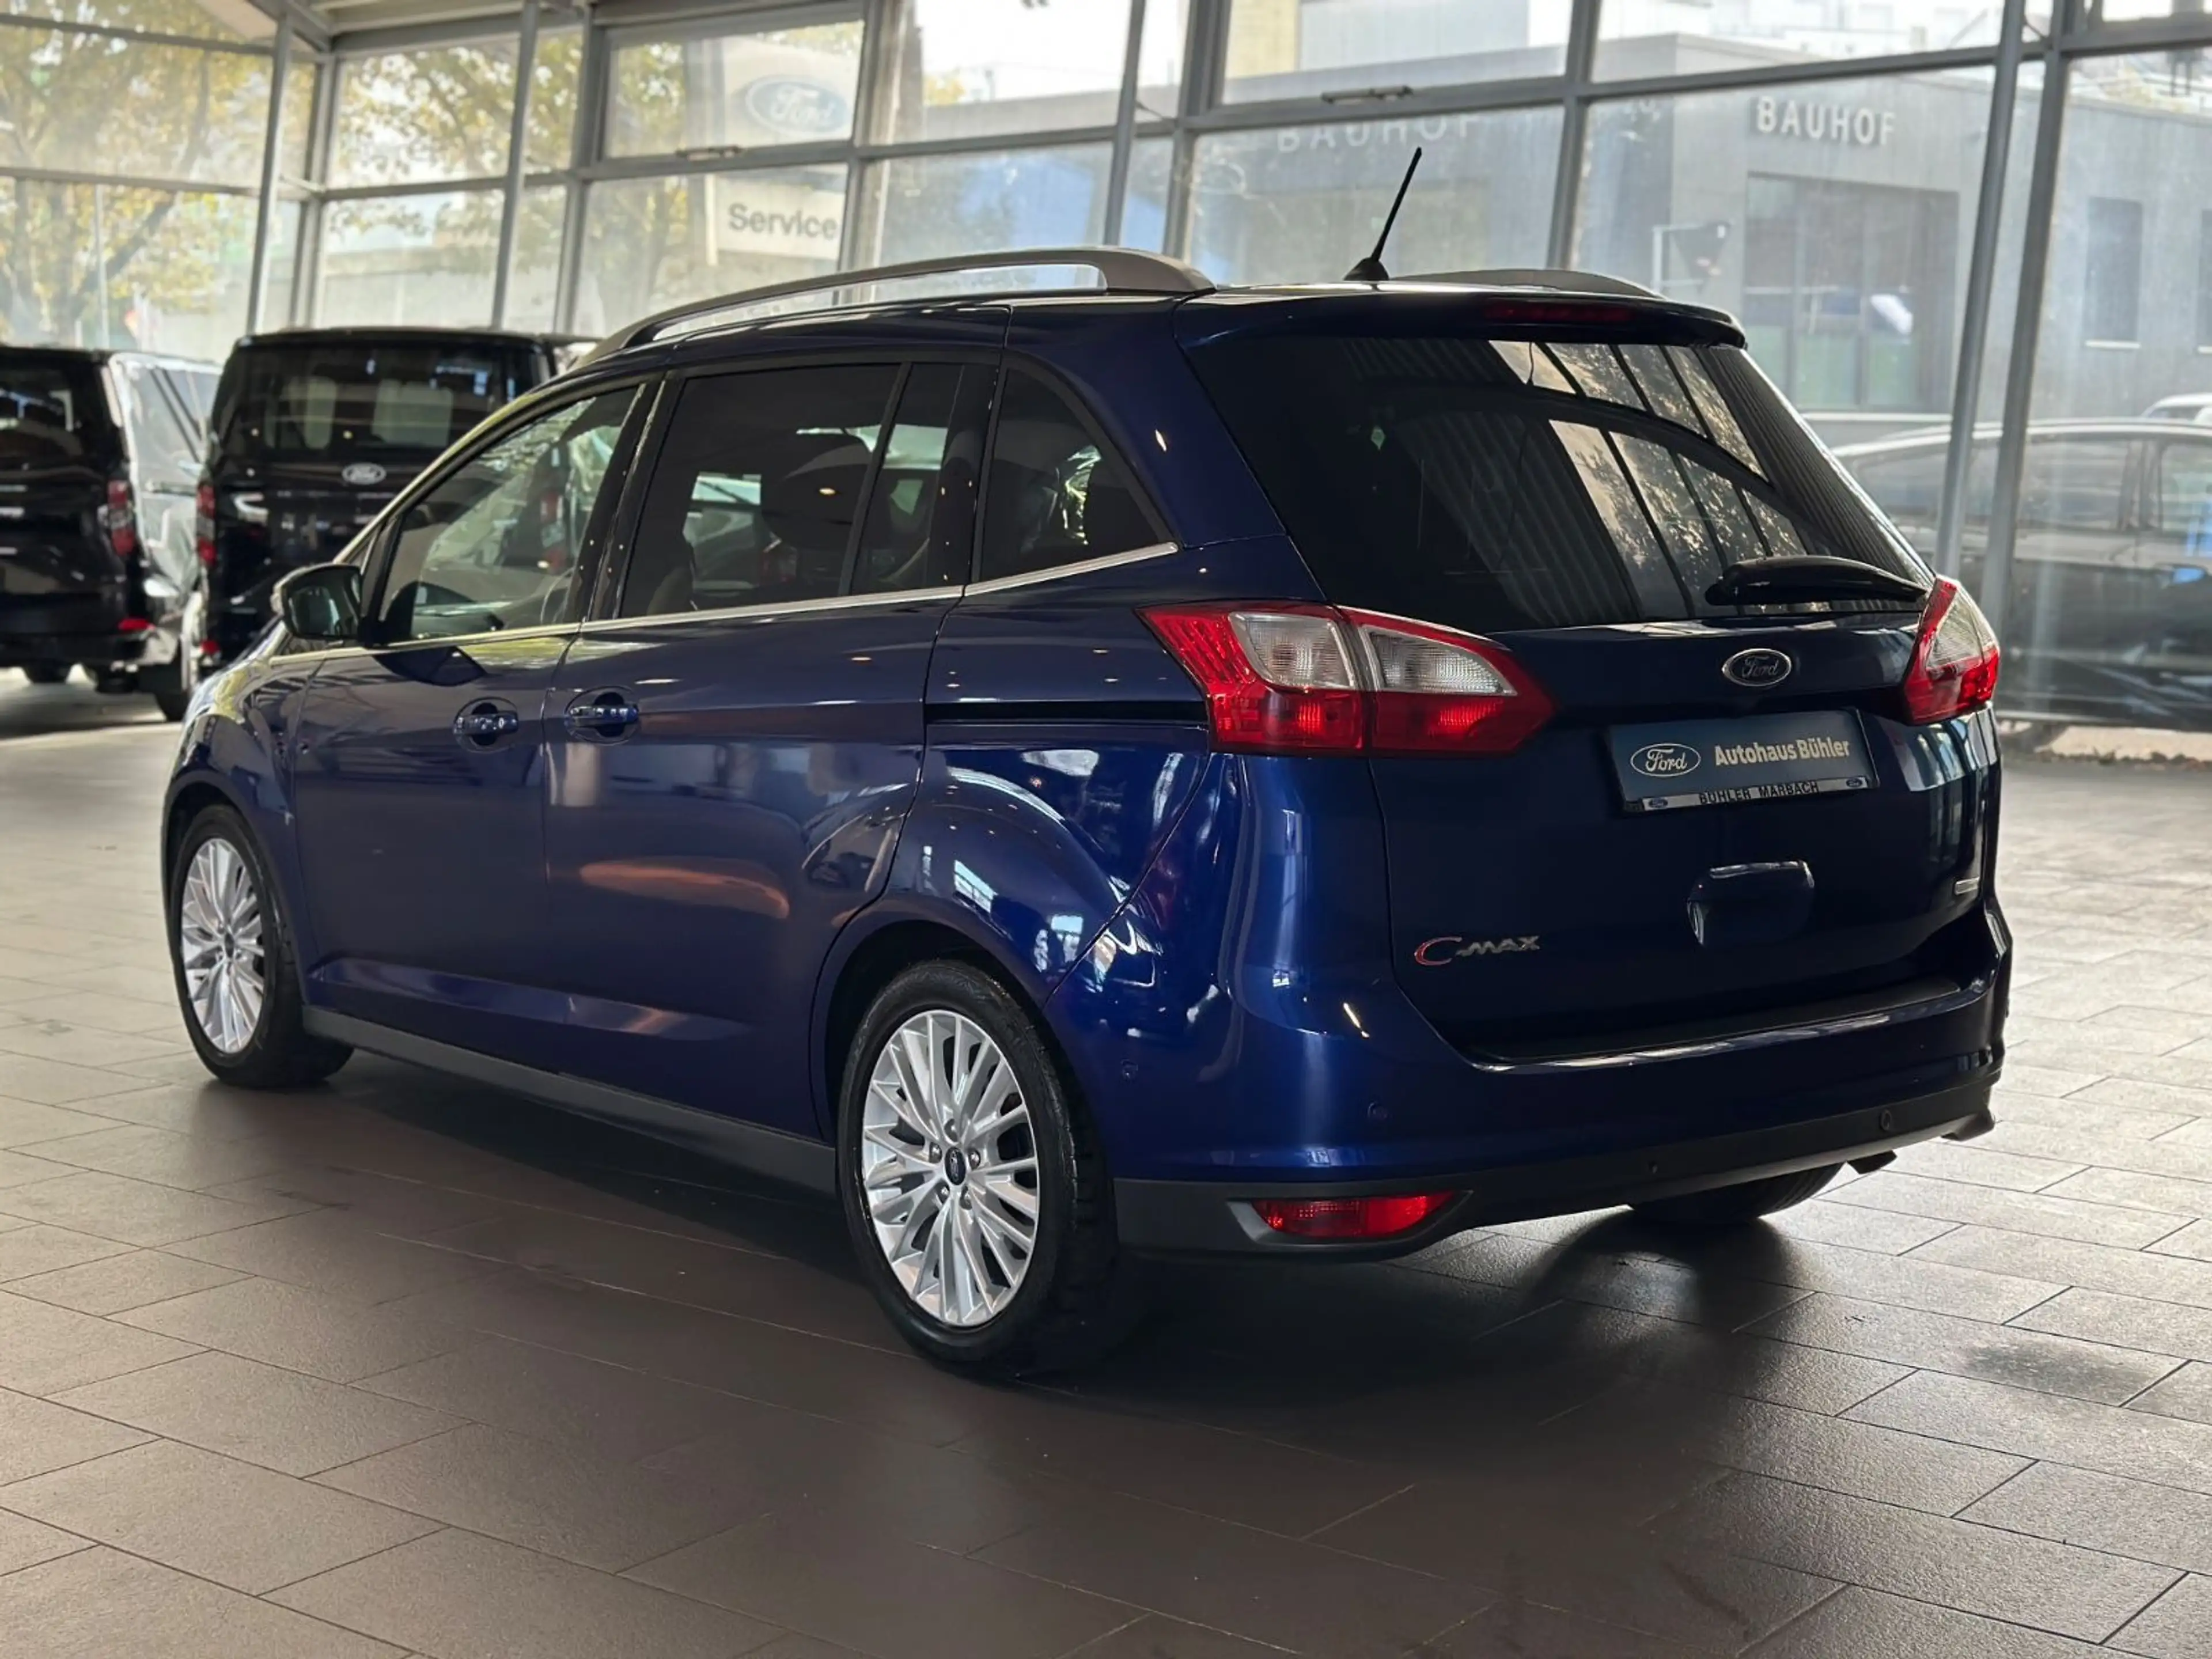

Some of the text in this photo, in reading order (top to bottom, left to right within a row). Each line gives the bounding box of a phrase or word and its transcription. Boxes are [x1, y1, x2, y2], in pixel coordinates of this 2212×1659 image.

[1757, 96, 1896, 145] BAUHOF
[728, 203, 839, 241] Service
[1741, 655, 1779, 679] Ford
[1645, 748, 1688, 772] Ford
[1714, 737, 1850, 766] Autohaus Bühler
[1759, 781, 1819, 797] MARBACH
